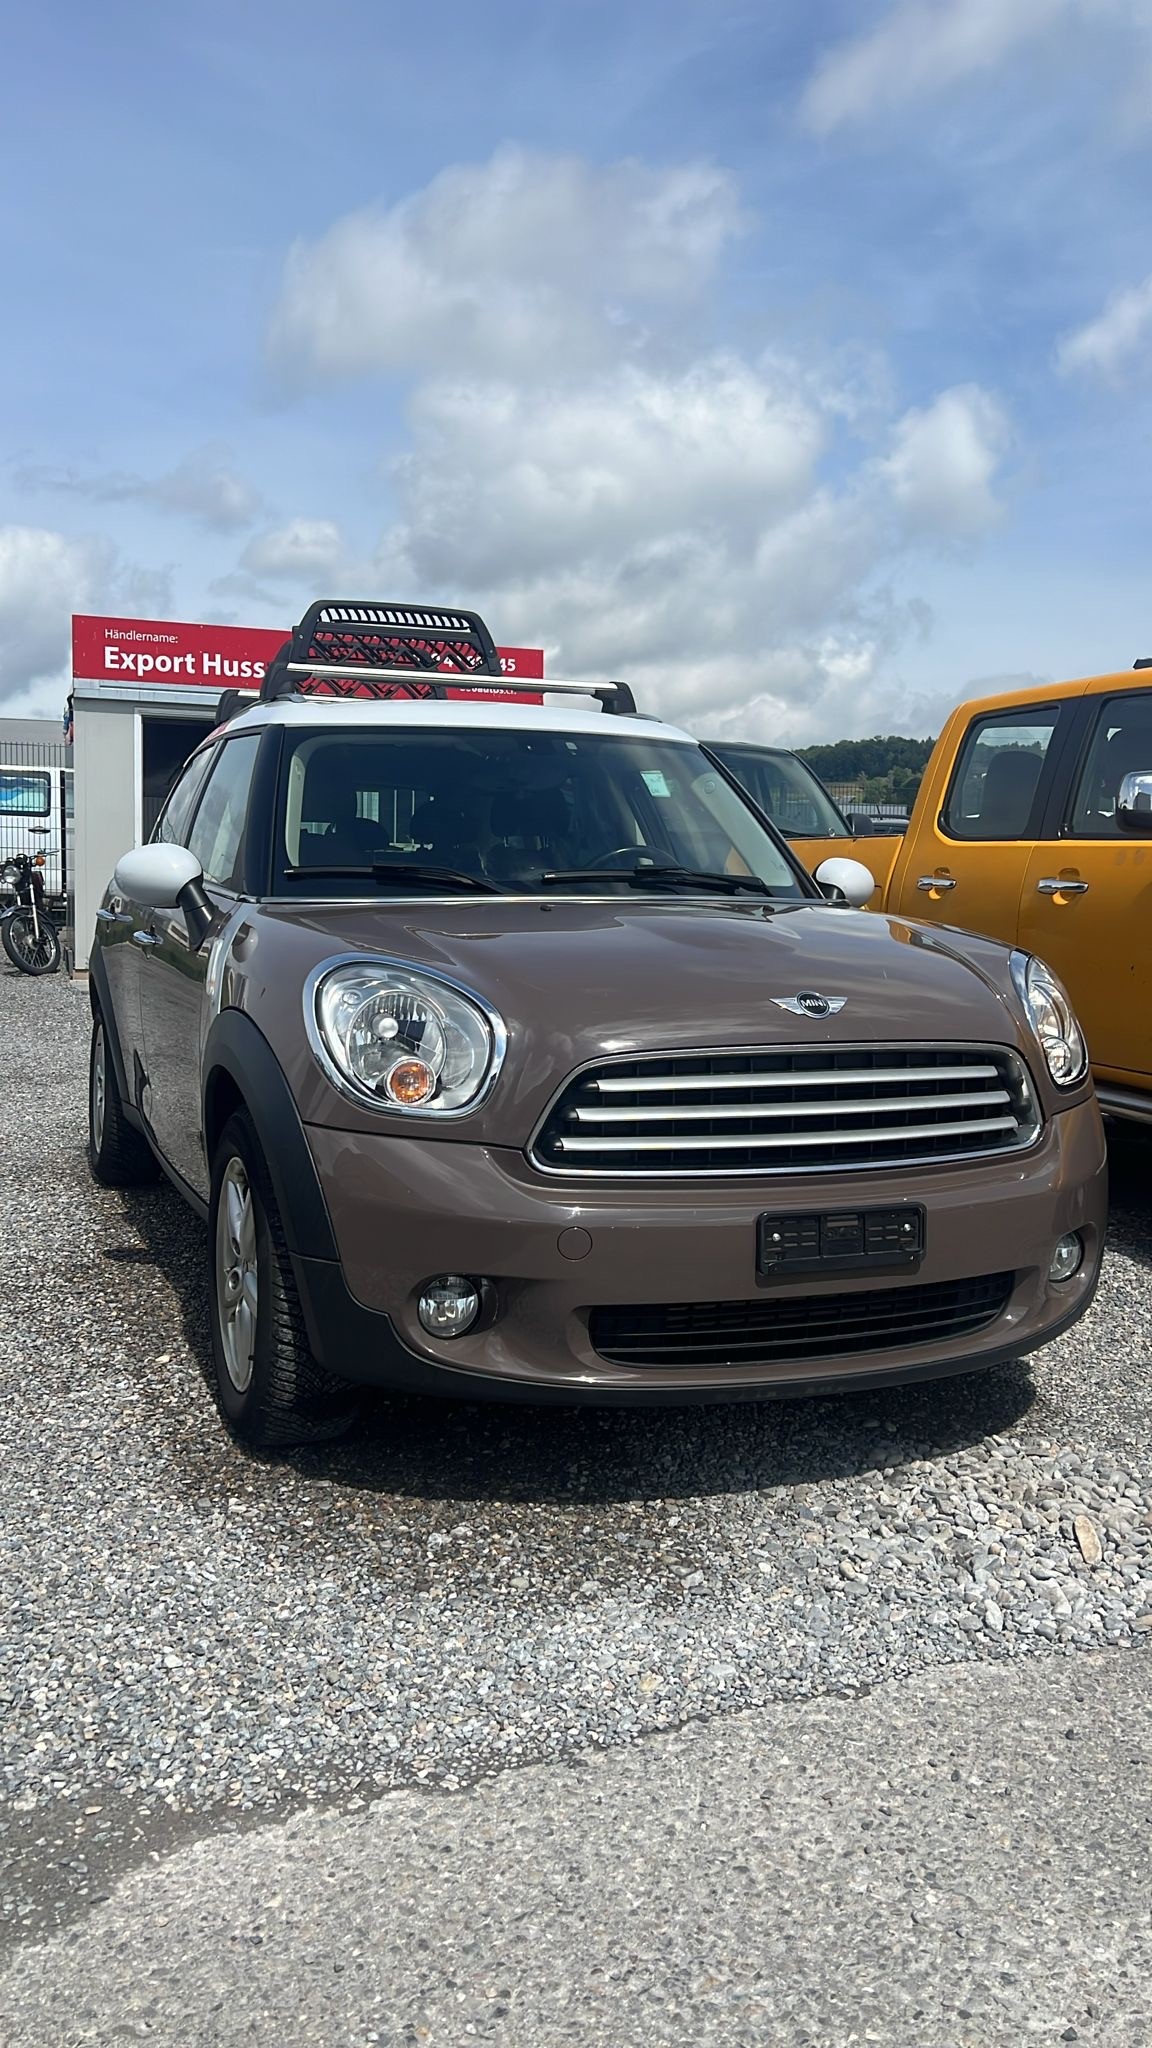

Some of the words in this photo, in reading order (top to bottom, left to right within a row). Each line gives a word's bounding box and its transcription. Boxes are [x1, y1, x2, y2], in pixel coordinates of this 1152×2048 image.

[104, 628, 178, 643] Händlername:
[104, 645, 196, 677] Export
[800, 998, 827, 1008] MINI
